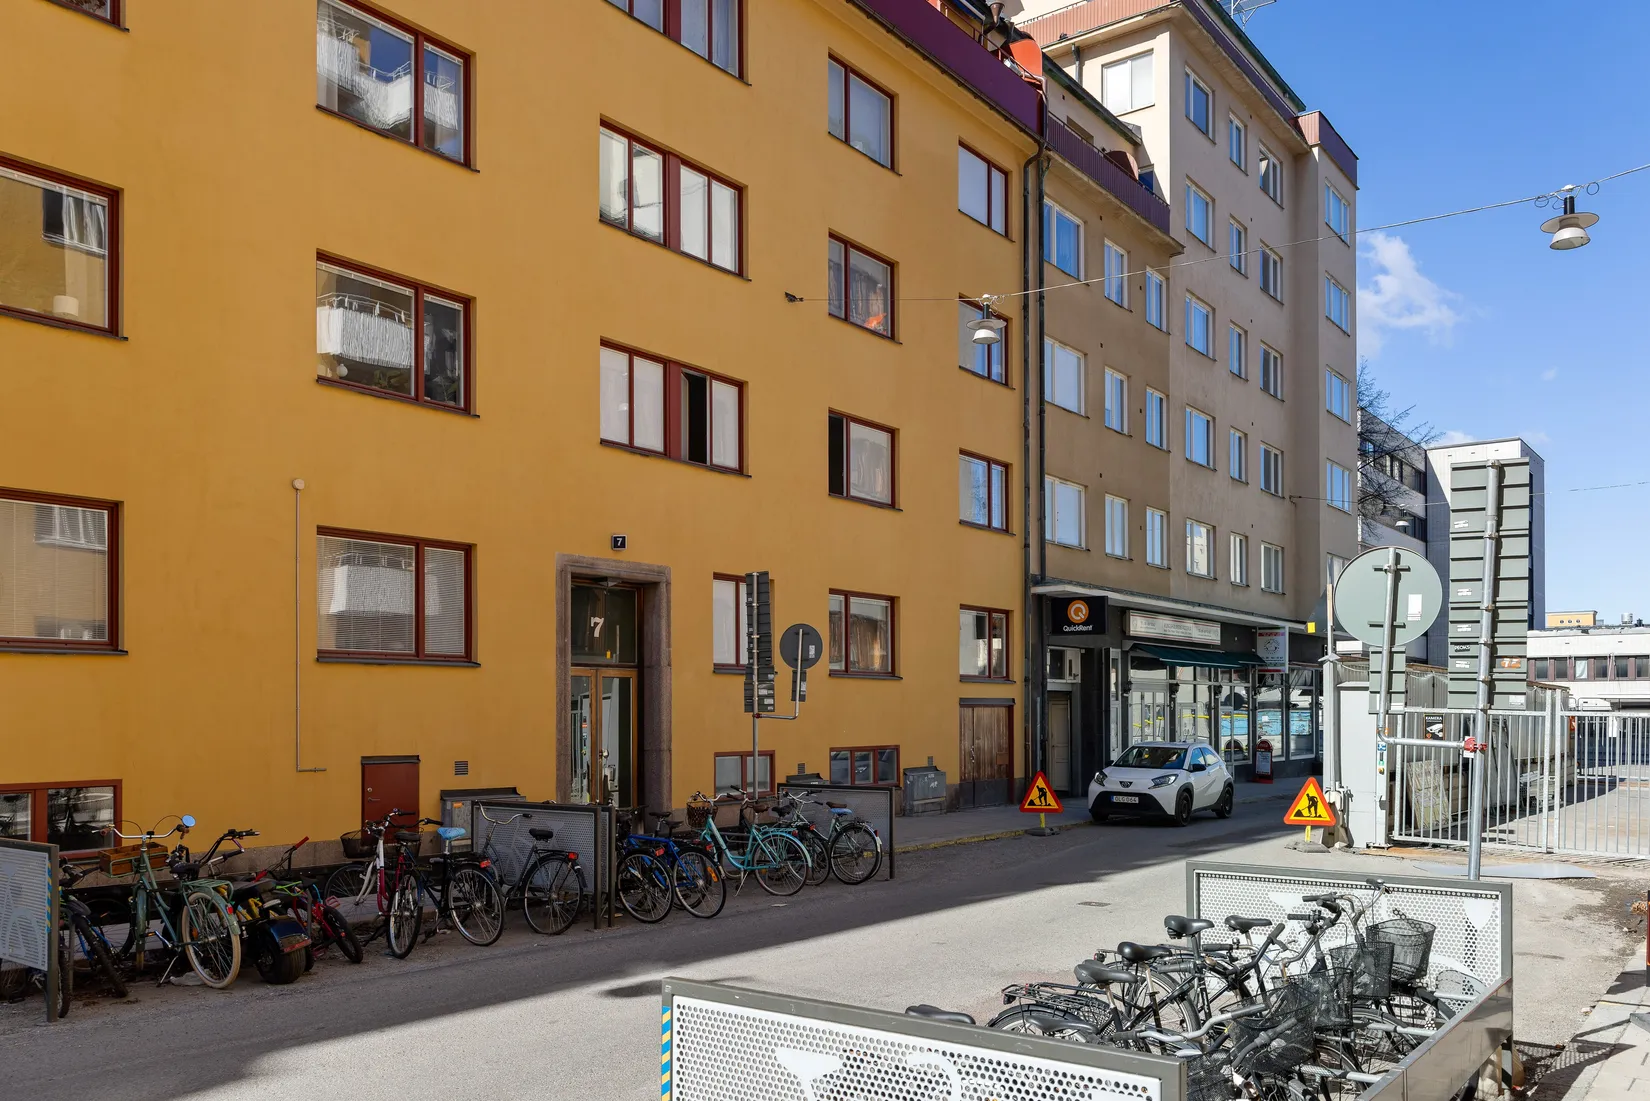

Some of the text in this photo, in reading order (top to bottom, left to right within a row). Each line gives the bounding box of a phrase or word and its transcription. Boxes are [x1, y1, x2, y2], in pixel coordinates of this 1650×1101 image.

[616, 538, 623, 546] 7
[590, 616, 604, 638] 7
[1062, 624, 1093, 632] QuickRent
